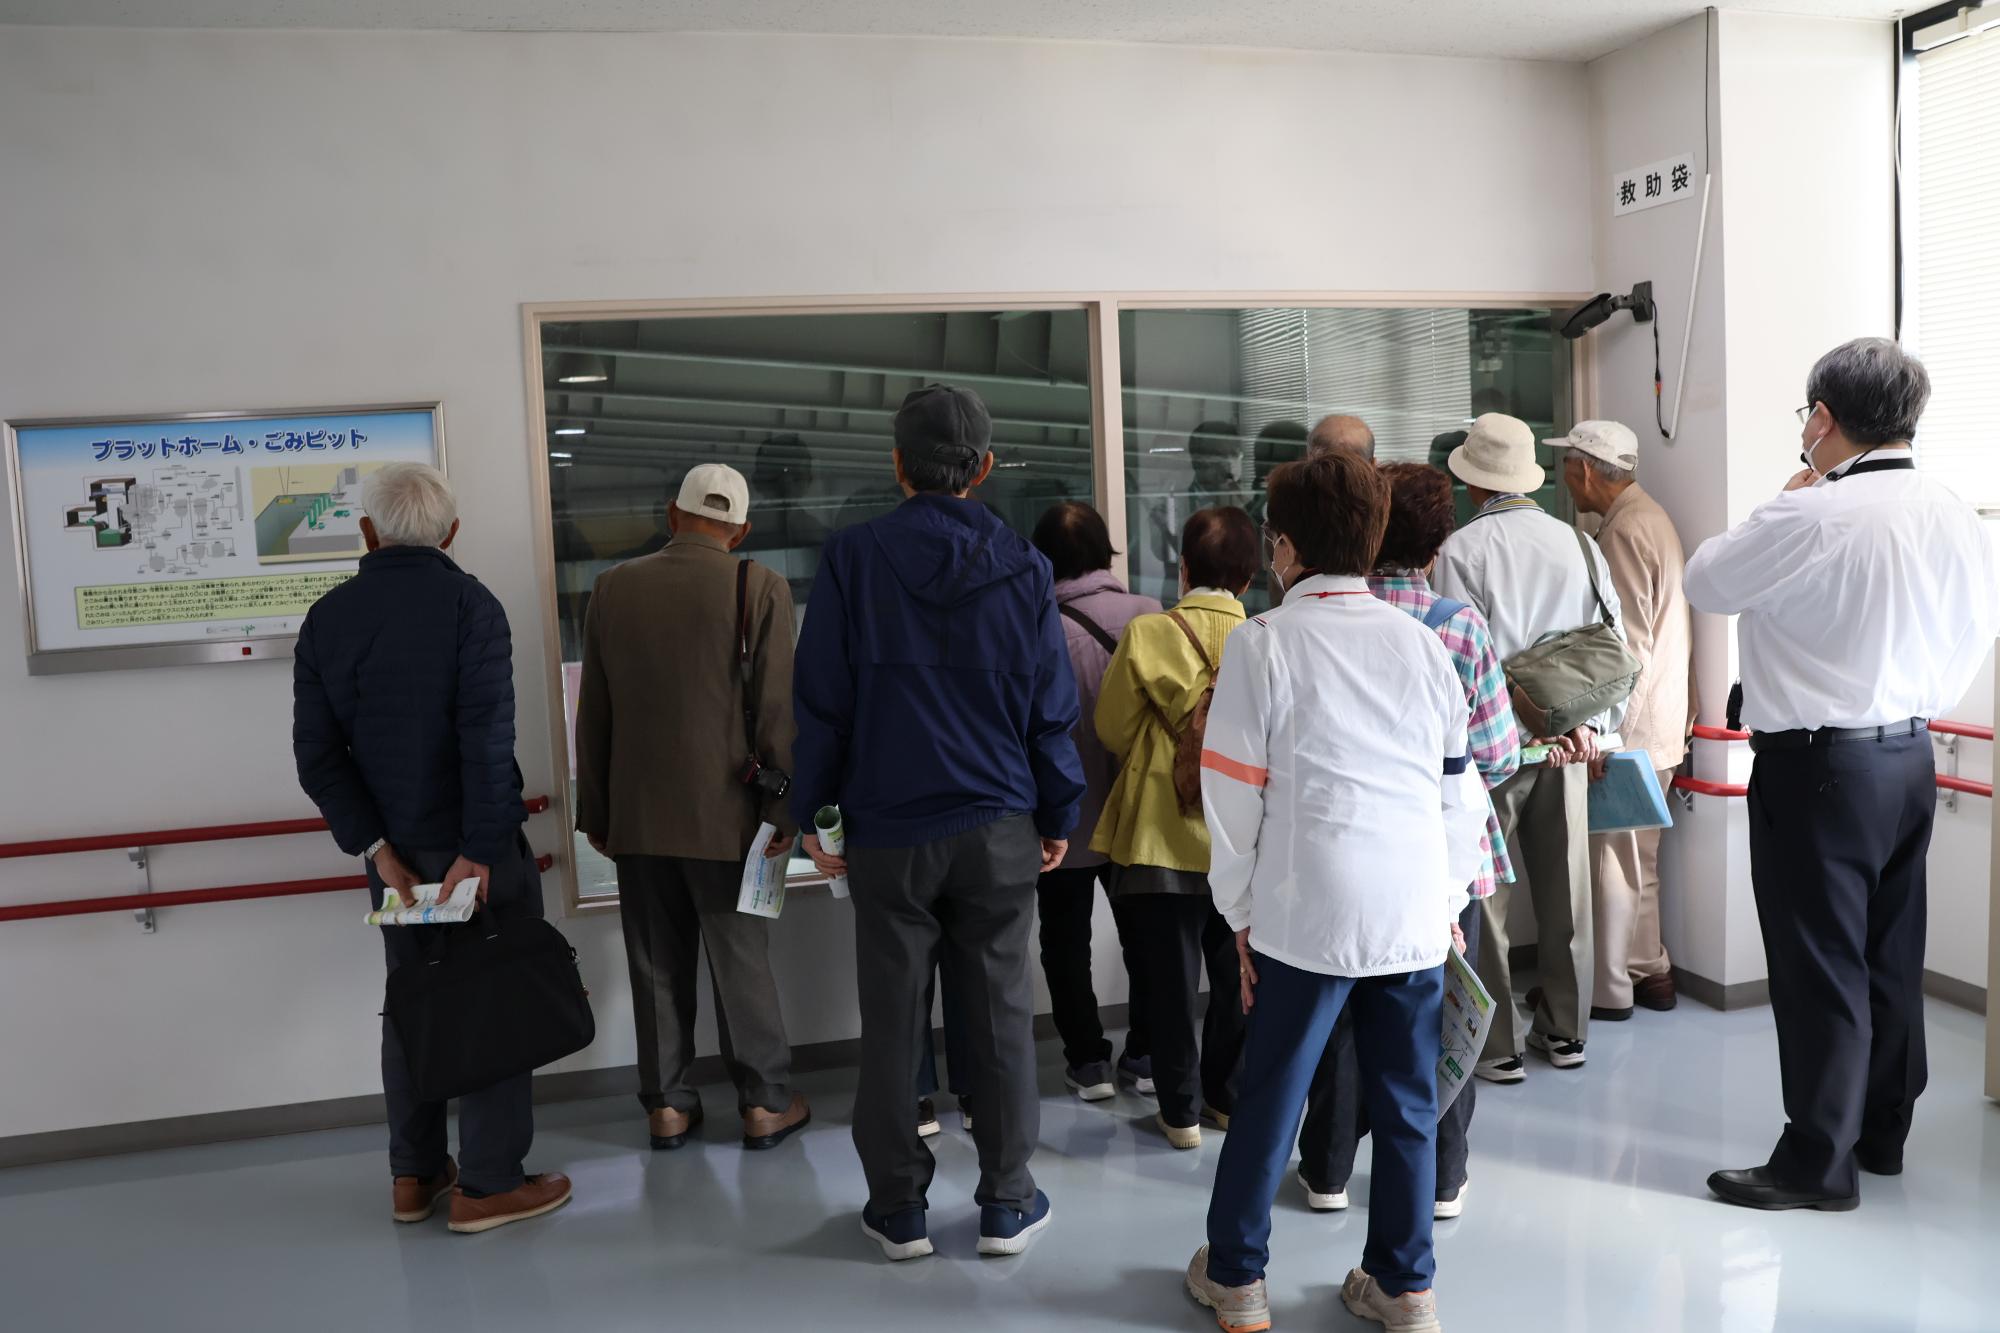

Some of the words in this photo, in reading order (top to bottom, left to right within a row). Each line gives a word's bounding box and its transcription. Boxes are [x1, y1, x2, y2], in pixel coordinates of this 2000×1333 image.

[1620, 163, 1689, 206] 救助袋
[91, 429, 368, 461] プラットホーム・ごみピット
